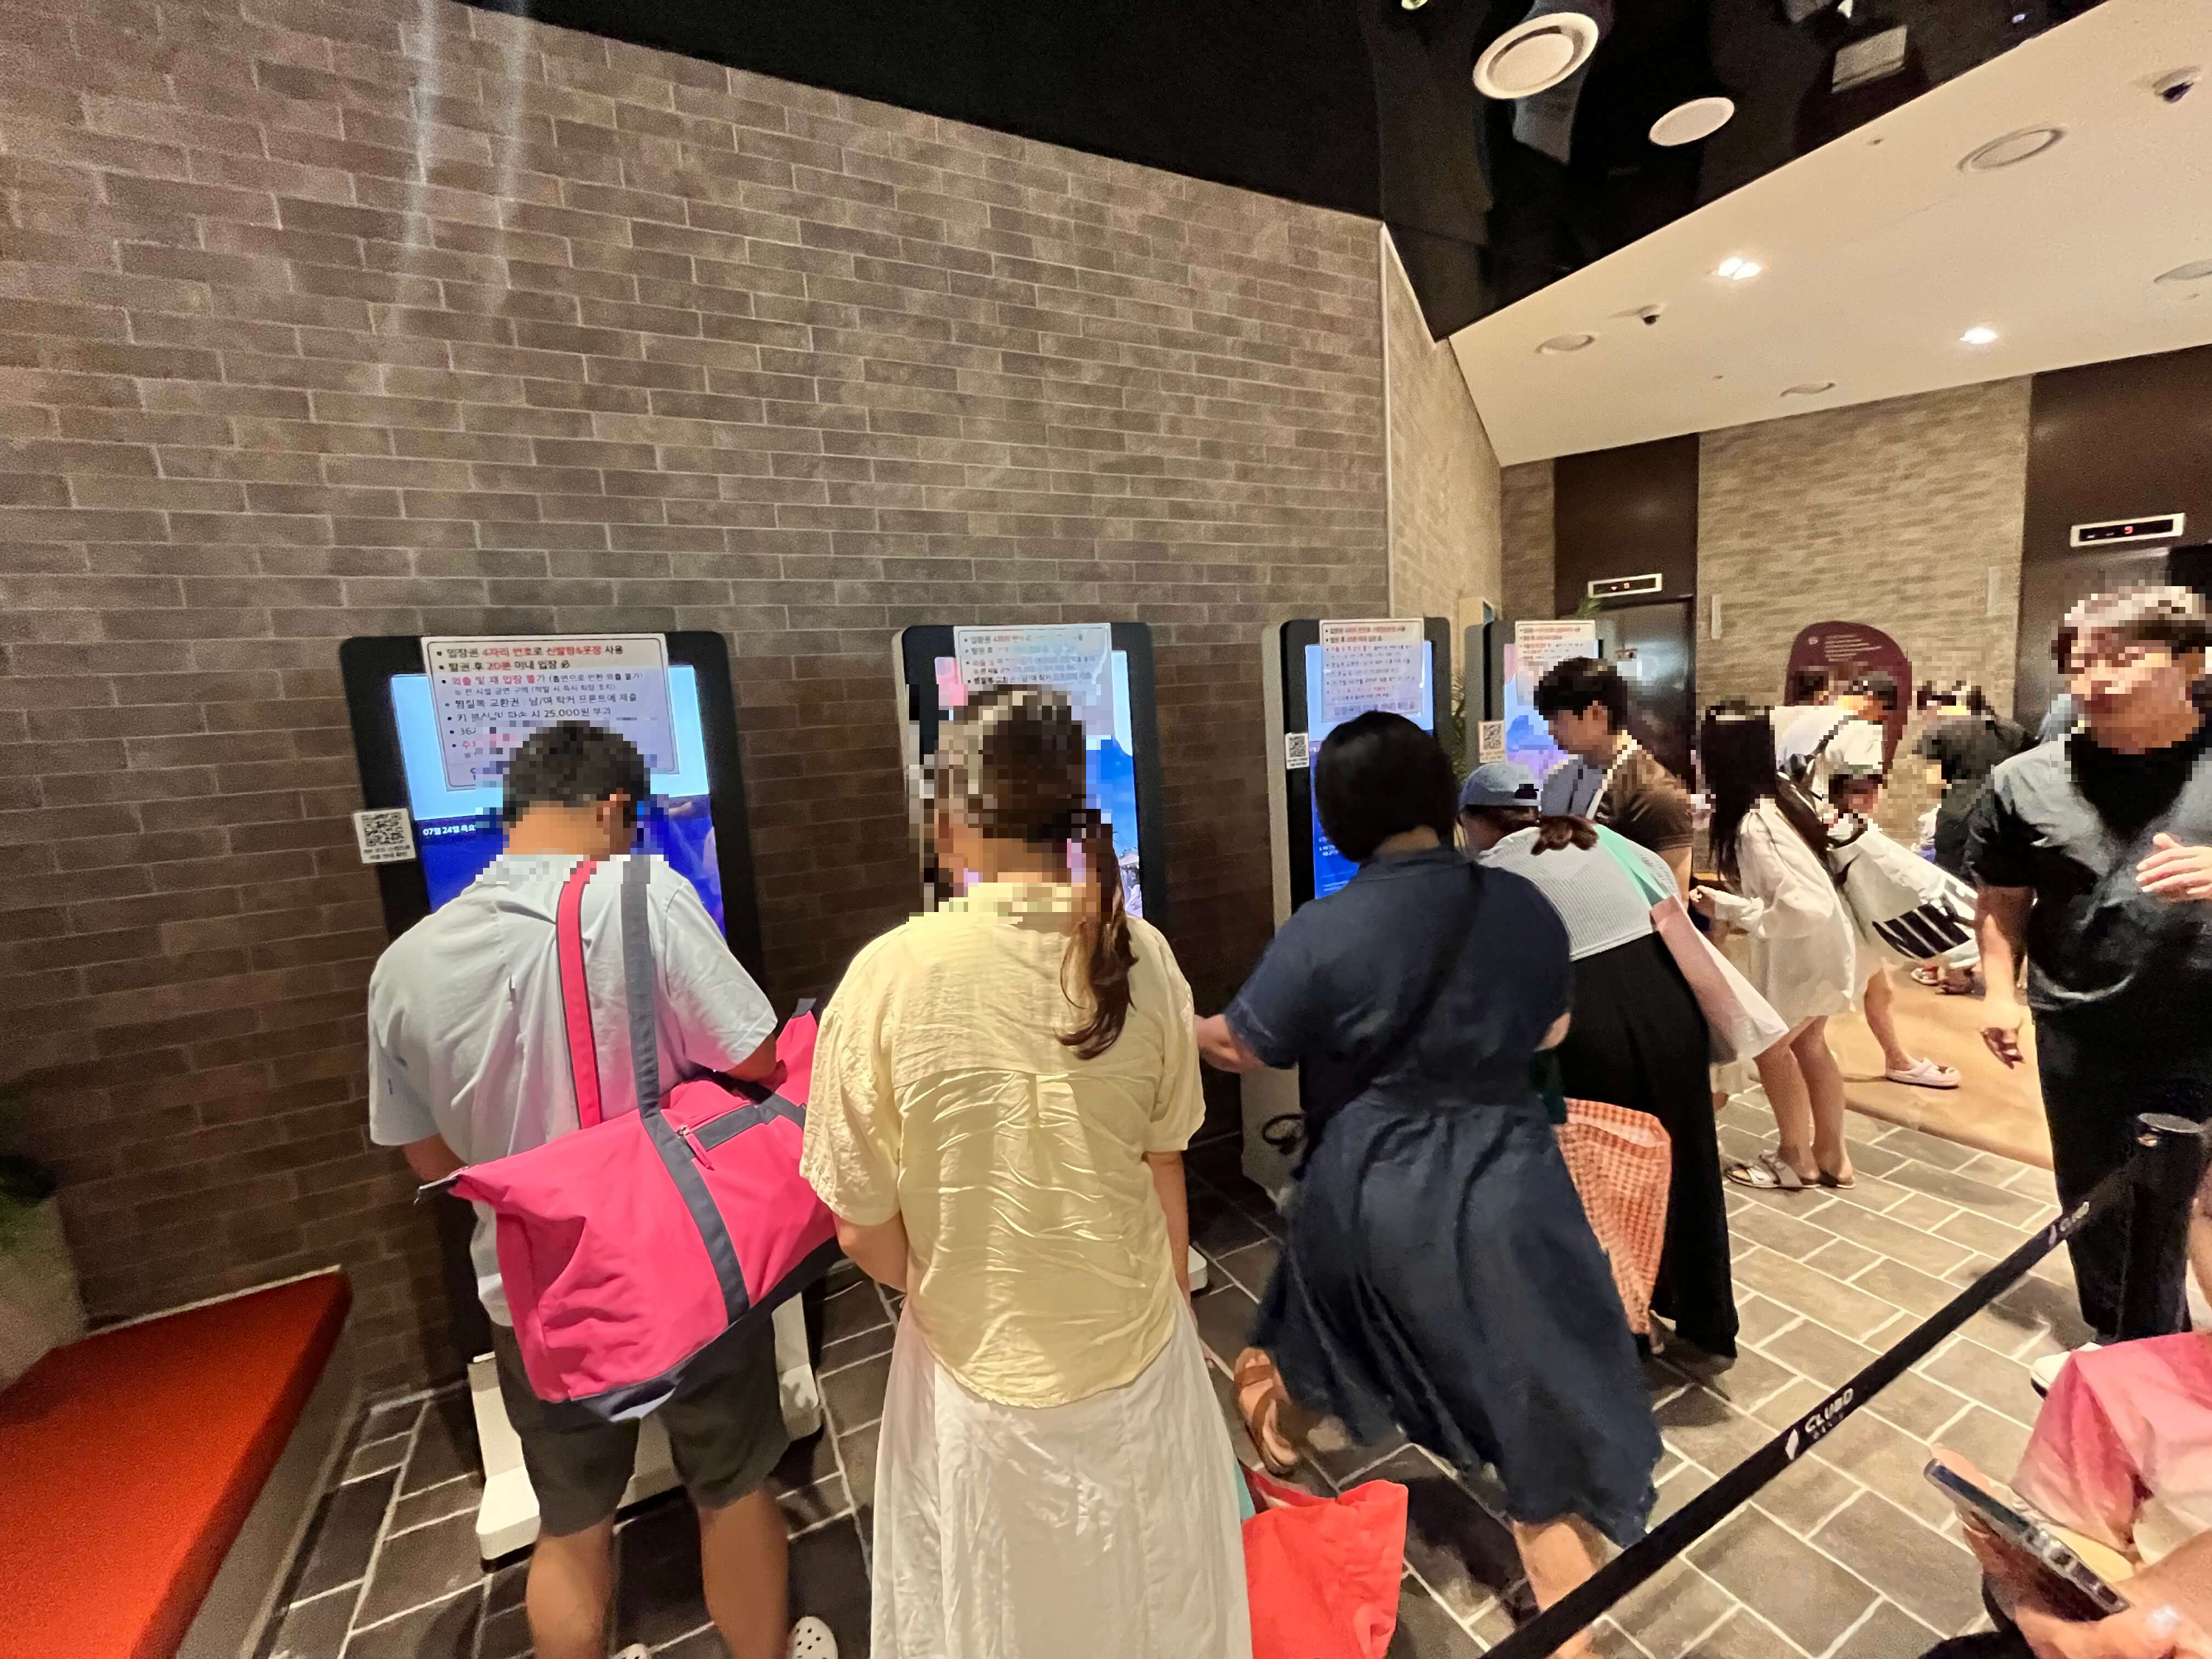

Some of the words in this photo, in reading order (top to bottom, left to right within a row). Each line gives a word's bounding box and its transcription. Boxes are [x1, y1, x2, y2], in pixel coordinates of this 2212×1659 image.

[447, 648, 479, 658] 입장권
[605, 645, 623, 655] 사용
[448, 663, 470, 672] 발권
[474, 661, 484, 670] 후
[487, 661, 511, 671] 20분
[514, 661, 534, 669] 이내
[538, 660, 557, 669] 입장
[451, 677, 471, 686] 외출
[475, 675, 484, 685] 및
[490, 675, 499, 684] 재
[502, 675, 522, 684] 입장
[526, 674, 545, 684] 불가
[588, 673, 603, 681] 인한
[495, 687, 510, 695] 금연
[513, 686, 529, 694] 구역
[490, 698, 519, 708] 교환권
[529, 696, 552, 706] 남/여
[556, 695, 575, 704] 락커
[619, 692, 637, 702] 제출
[531, 709, 540, 718] 시
[543, 707, 589, 718] 25,000원
[593, 706, 611, 715] 부과
[422, 827, 441, 836] 07월
[442, 825, 459, 834] 24일
[461, 824, 476, 832] 목요
